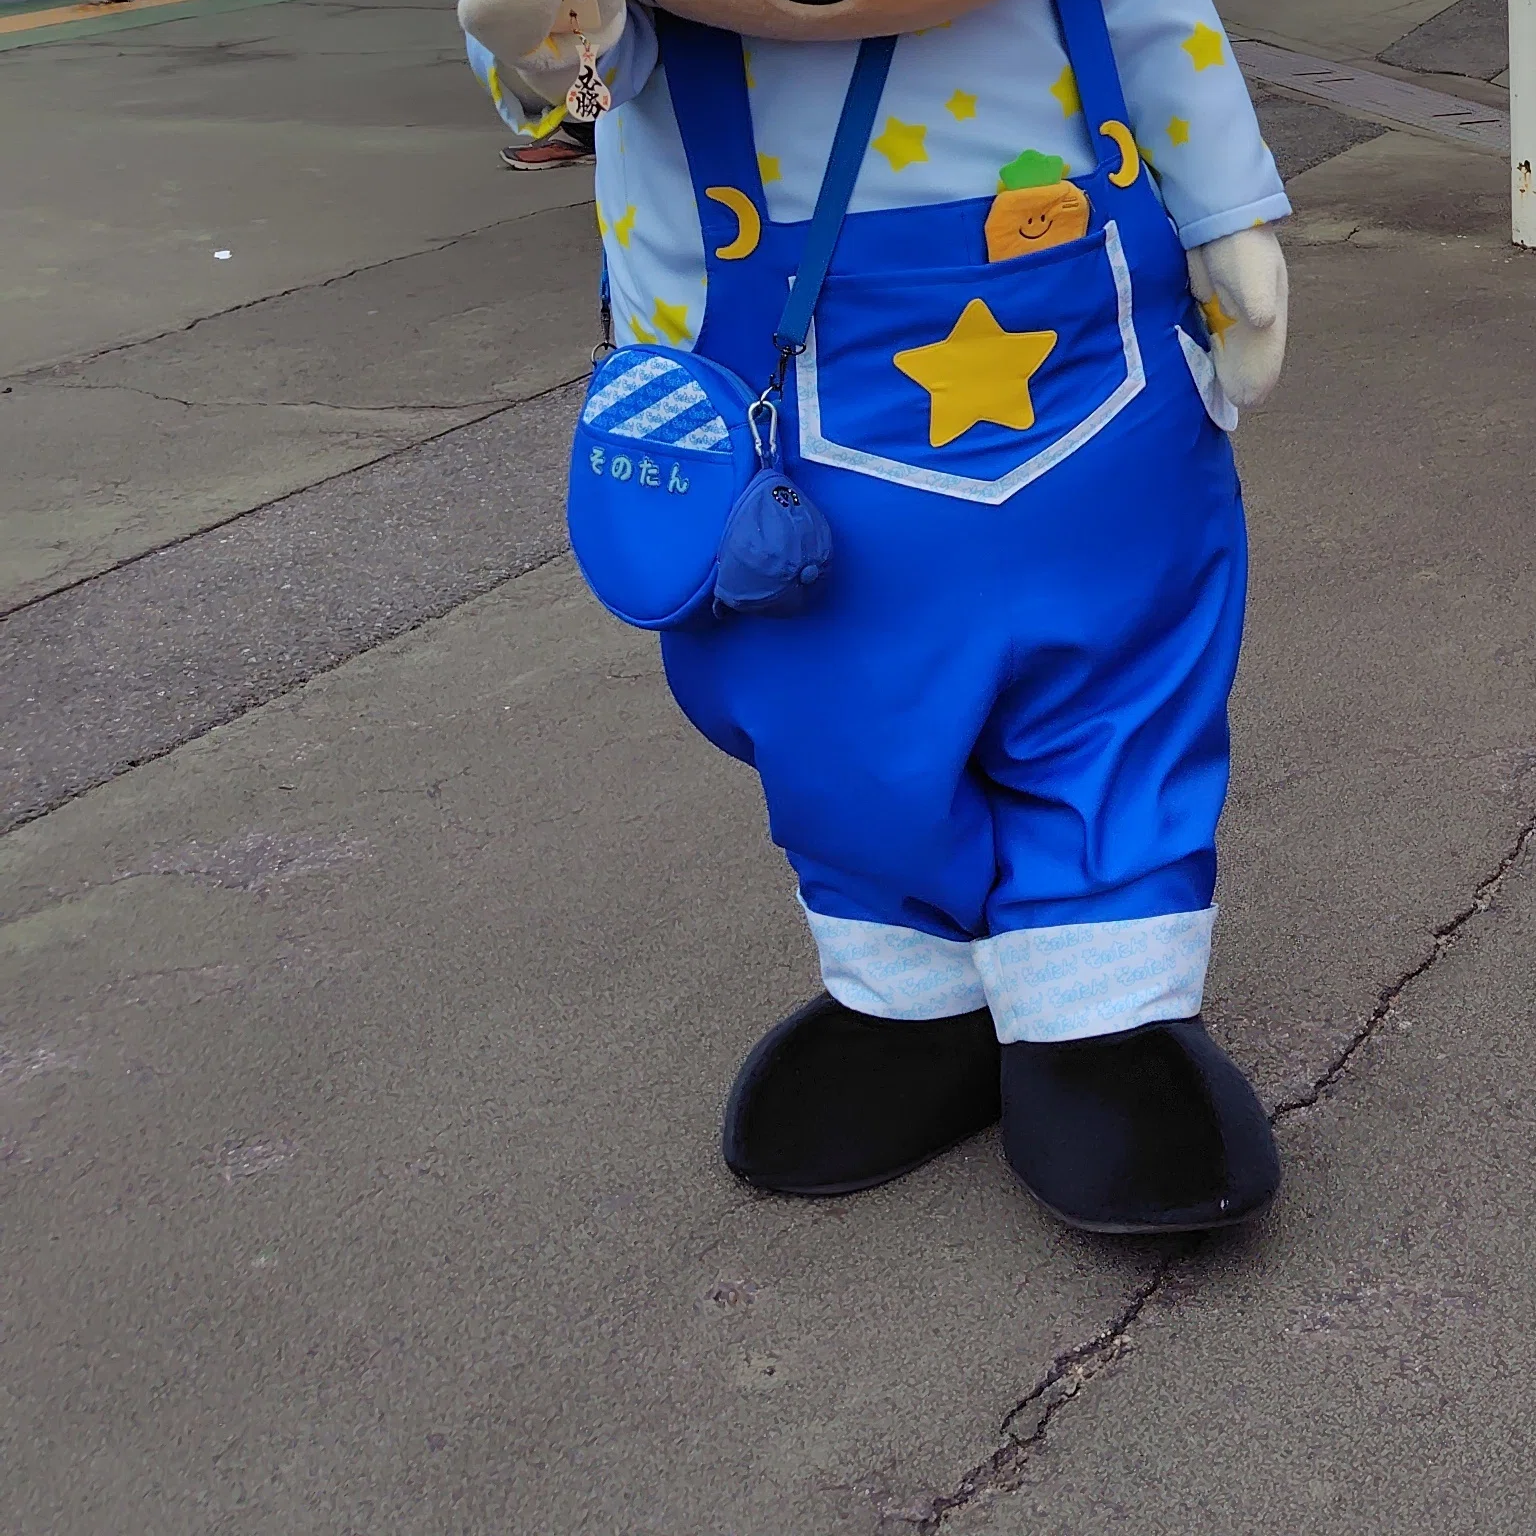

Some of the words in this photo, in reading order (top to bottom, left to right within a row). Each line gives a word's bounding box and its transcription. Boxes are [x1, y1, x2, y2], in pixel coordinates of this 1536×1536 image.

[575, 65, 607, 119] 必勝
[589, 446, 690, 495] そのたん
